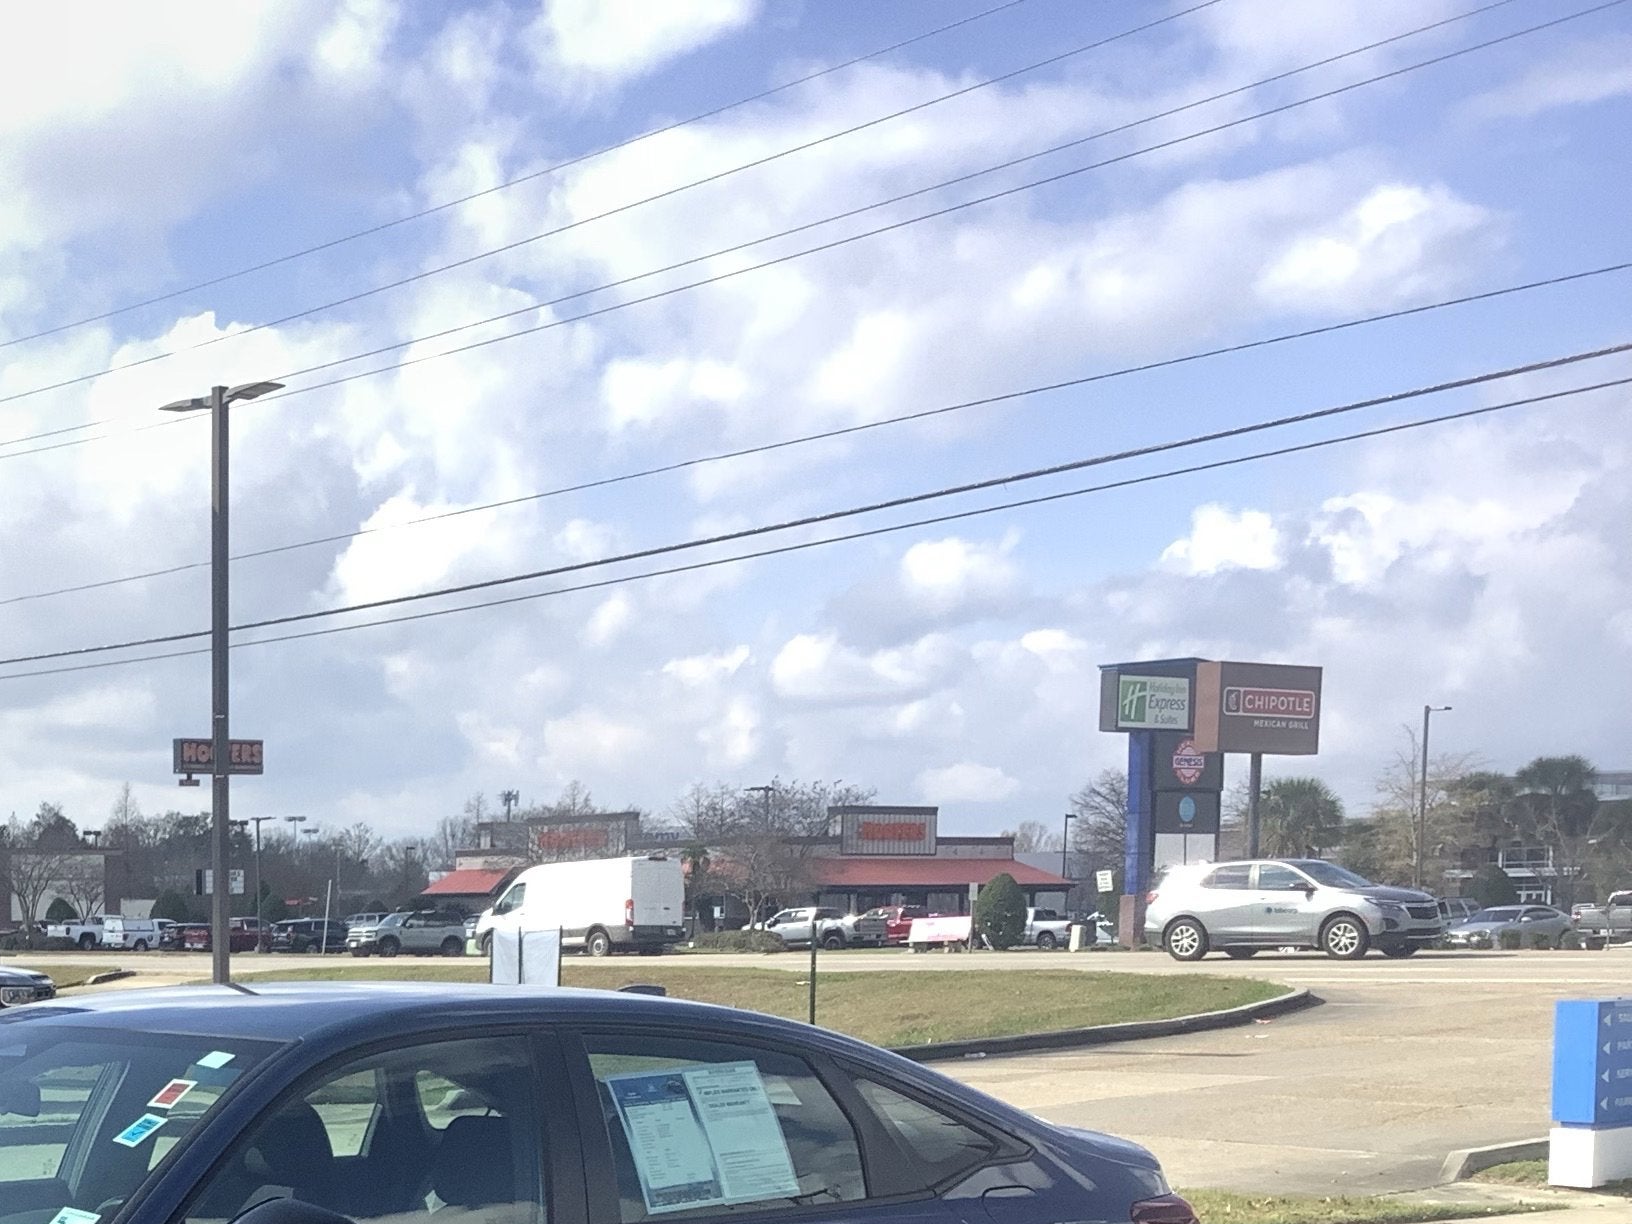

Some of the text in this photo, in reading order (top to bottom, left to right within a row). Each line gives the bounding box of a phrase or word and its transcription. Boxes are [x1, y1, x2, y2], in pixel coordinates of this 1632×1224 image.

[1148, 693, 1186, 713] Express
[1244, 695, 1310, 712] CHIPOTLE
[1254, 720, 1309, 729] MEXICAN GRILL
